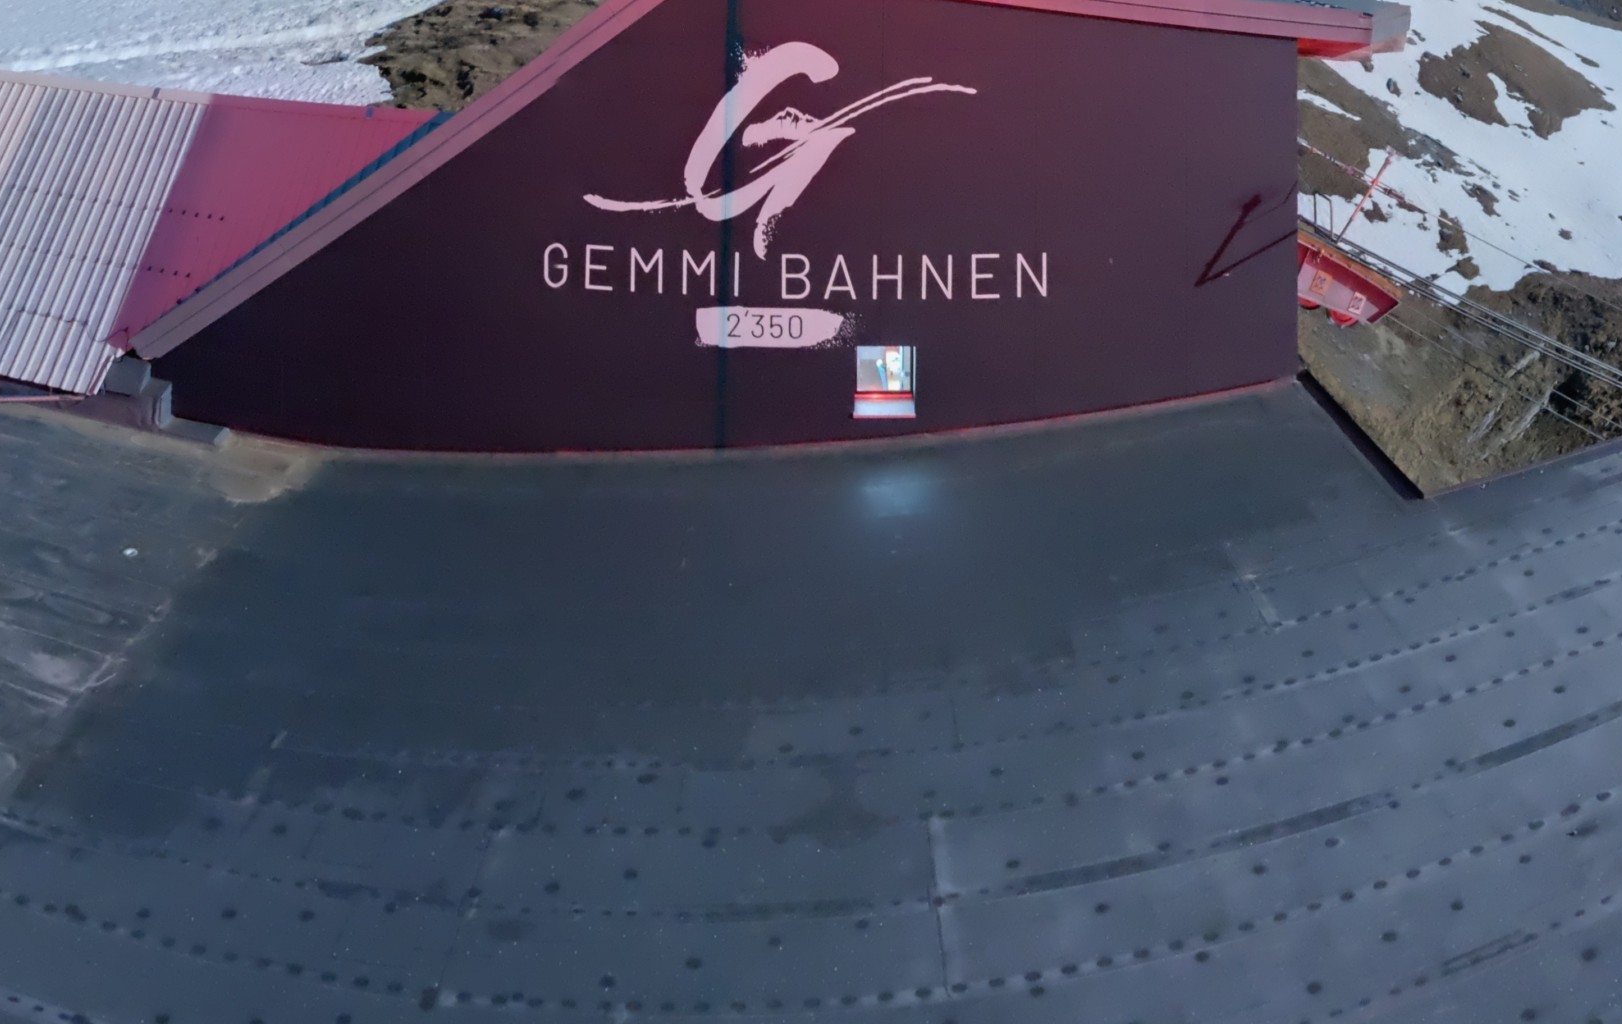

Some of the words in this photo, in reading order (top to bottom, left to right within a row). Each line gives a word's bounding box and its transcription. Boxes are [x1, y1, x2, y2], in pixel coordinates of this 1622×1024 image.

[543, 243, 740, 297] GEMMI
[781, 252, 1048, 300] BAHNEN
[727, 310, 803, 339] 2'350
